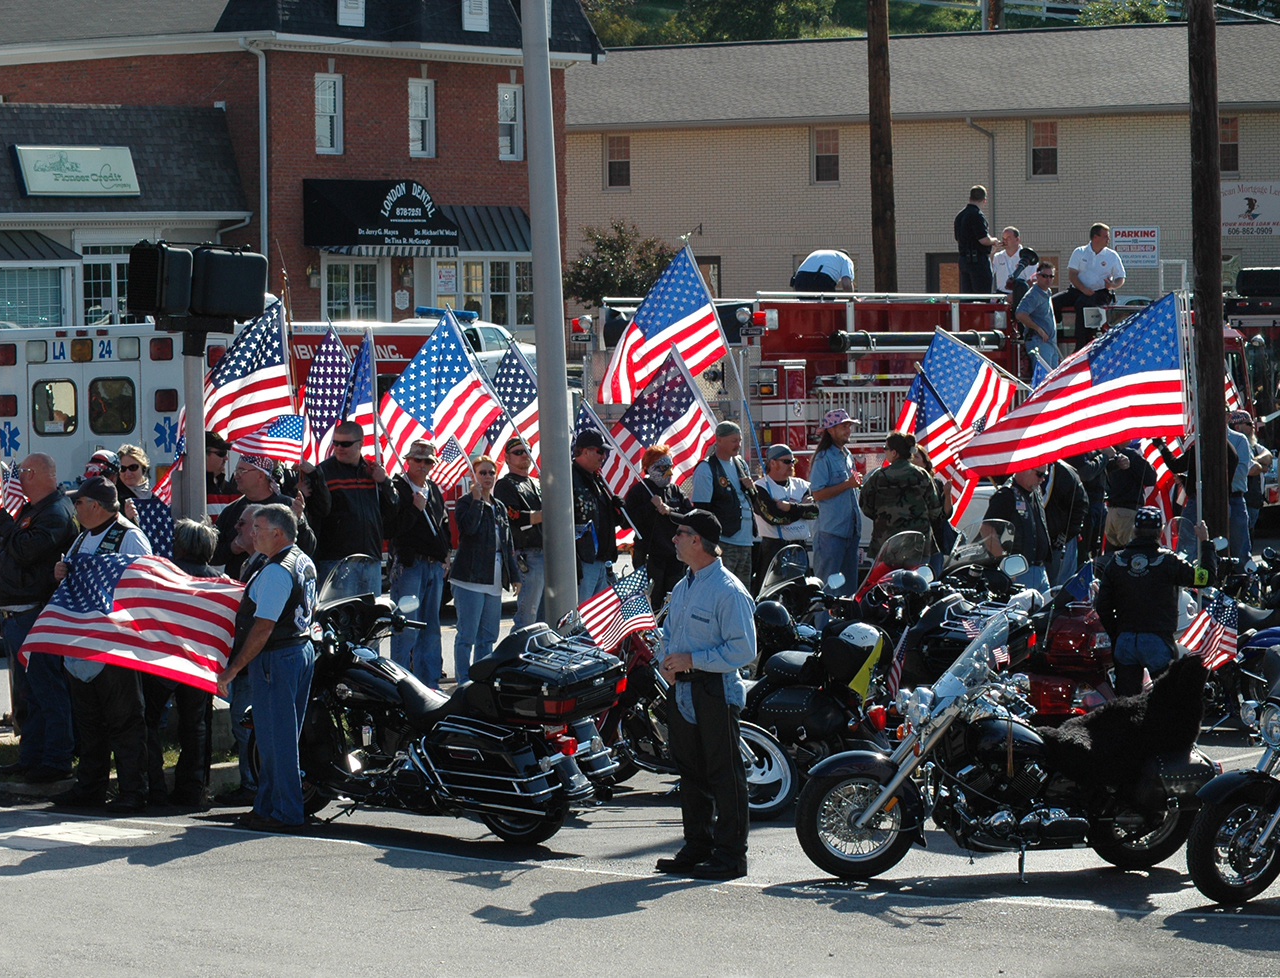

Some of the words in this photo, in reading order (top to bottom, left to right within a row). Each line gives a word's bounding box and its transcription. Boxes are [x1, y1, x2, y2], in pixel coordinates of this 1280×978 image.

[53, 174, 90, 182] Pioneer
[90, 173, 122, 182] Credit
[380, 182, 407, 218] LONDON
[412, 182, 436, 218] DENTAL
[1114, 230, 1156, 238] PARKING
[52, 342, 66, 360] LA
[98, 340, 112, 358] 24
